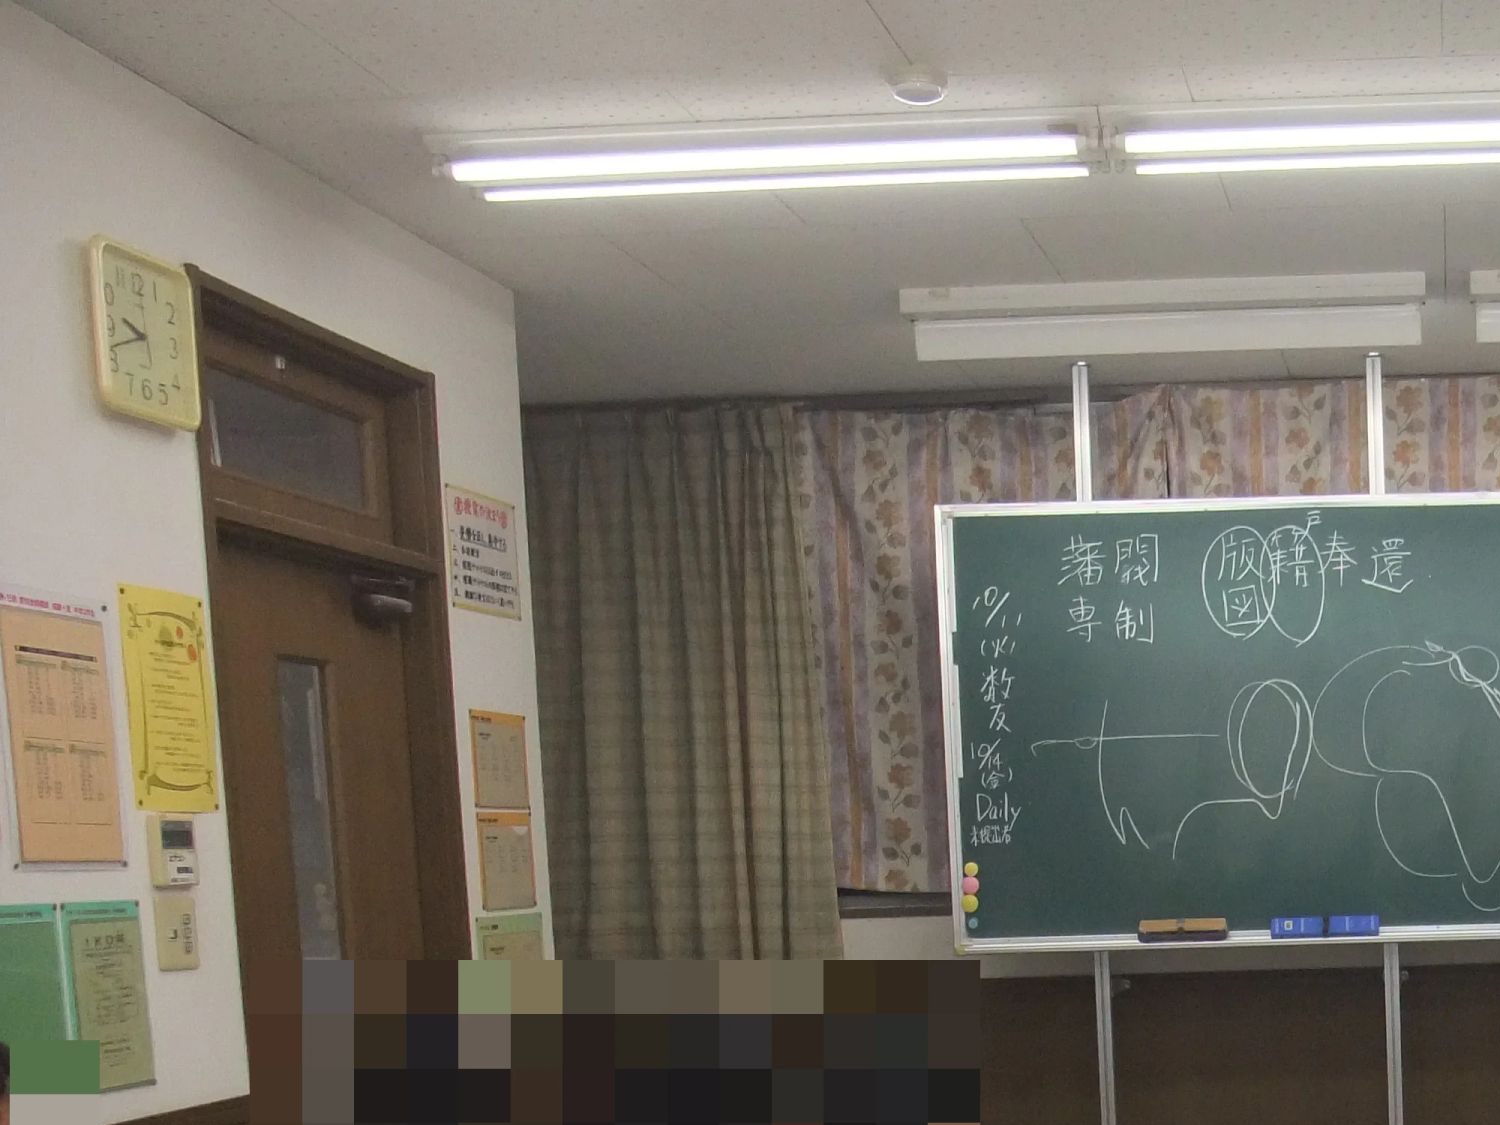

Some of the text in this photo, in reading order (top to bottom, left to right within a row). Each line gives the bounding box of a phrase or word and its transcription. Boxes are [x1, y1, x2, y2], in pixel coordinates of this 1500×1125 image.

[166, 302, 175, 325] 2
[169, 337, 179, 360] 3
[124, 371, 135, 396] 7
[141, 378, 153, 401] 6
[158, 383, 169, 406] 5
[1067, 596, 1154, 643] 専制
[976, 791, 1022, 831] Daily
